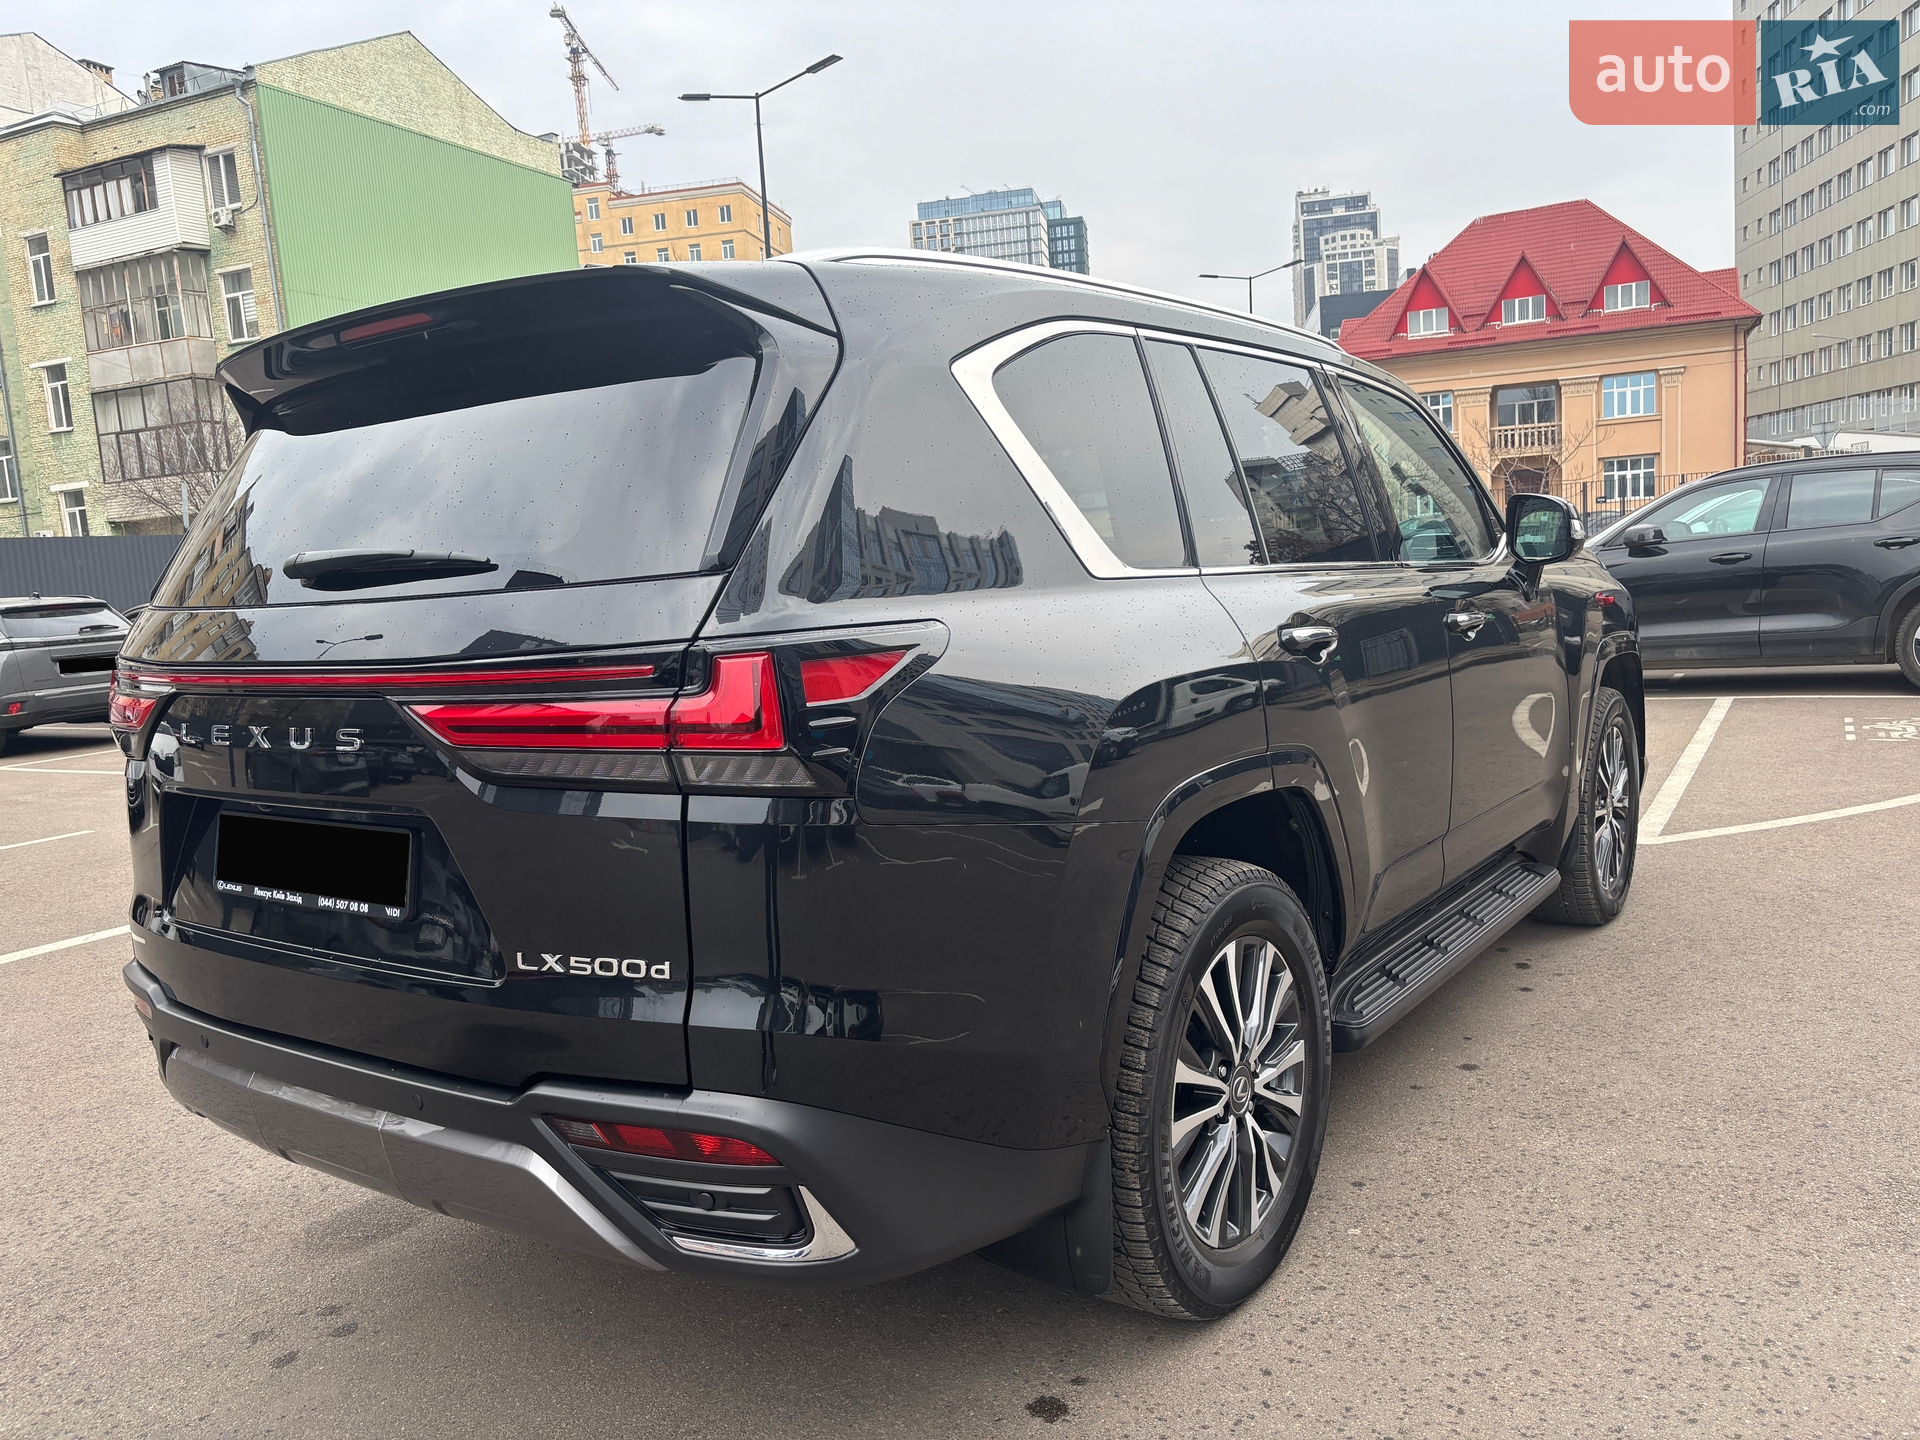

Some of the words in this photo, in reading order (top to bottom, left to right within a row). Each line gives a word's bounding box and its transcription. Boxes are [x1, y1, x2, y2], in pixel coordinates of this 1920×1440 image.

[180, 722, 364, 752] LEXUS
[223, 882, 243, 892] LEXUS
[253, 886, 272, 900] Лексус
[272, 889, 285, 900] Київ
[285, 891, 303, 905] Захід
[317, 895, 335, 909] (044)
[335, 900, 349, 910] 507
[349, 901, 359, 912] 08
[359, 903, 369, 913] 08
[384, 906, 401, 918] VIDI
[1307, 943, 1331, 1058] MICHELIN
[1159, 1134, 1193, 1268] MICHELIN
